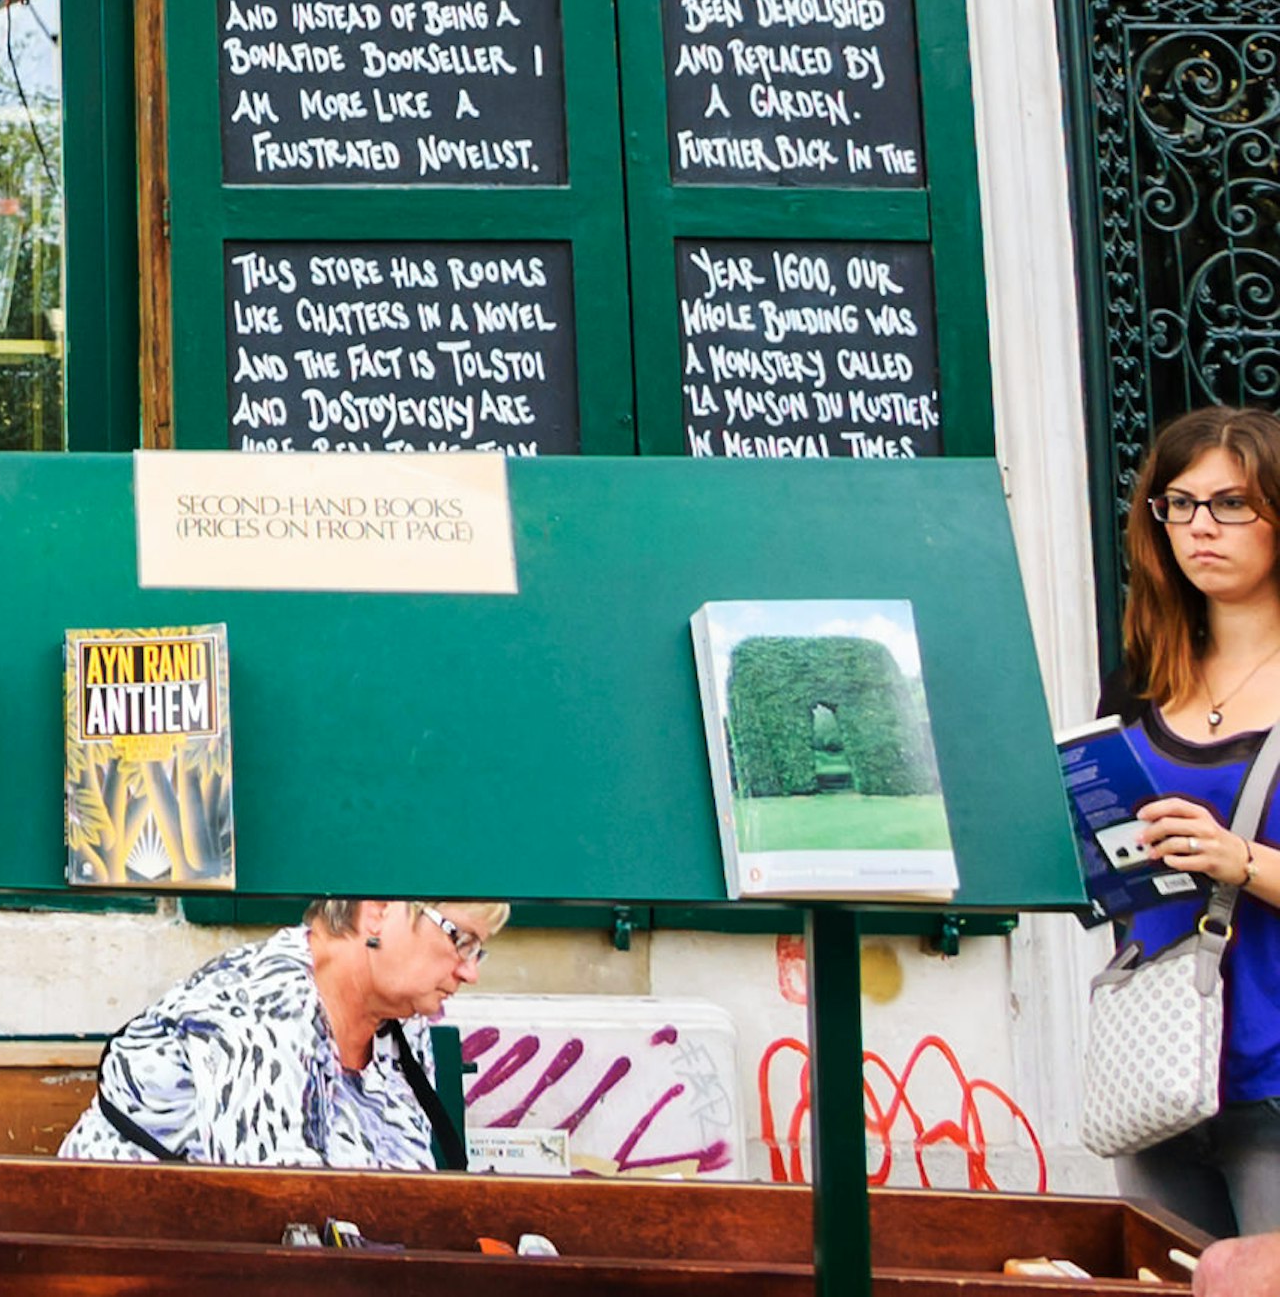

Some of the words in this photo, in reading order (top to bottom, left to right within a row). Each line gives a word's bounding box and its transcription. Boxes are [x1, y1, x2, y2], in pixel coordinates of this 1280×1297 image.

[252, 130, 401, 172] FRUSTRATED
[417, 134, 539, 176] NOVELIST.
[231, 252, 297, 295] THIS
[309, 256, 384, 289] STORE
[390, 256, 439, 289] HAS
[447, 257, 547, 291] ROOMS
[690, 247, 766, 294] YEAR
[773, 251, 837, 297] 1600,
[846, 257, 904, 296] OUR
[234, 300, 283, 334] LIKE
[296, 298, 410, 336] CHAPTERS
[417, 302, 442, 332] IN
[449, 303, 469, 332] A
[472, 301, 557, 334] NOVEL
[681, 297, 757, 337] WHOLE
[759, 300, 859, 343] BUILDING
[865, 304, 918, 336] WAS
[176, 494, 367, 518] SECOND-HAND
[374, 498, 464, 519] BOOKS
[176, 517, 261, 541] (PRICES
[265, 519, 309, 539] ON
[316, 519, 397, 540] FRONT
[406, 521, 474, 544] PAGE)
[87, 645, 134, 684] AYN
[143, 643, 206, 682] RAND
[86, 683, 209, 735] ANTHEM
